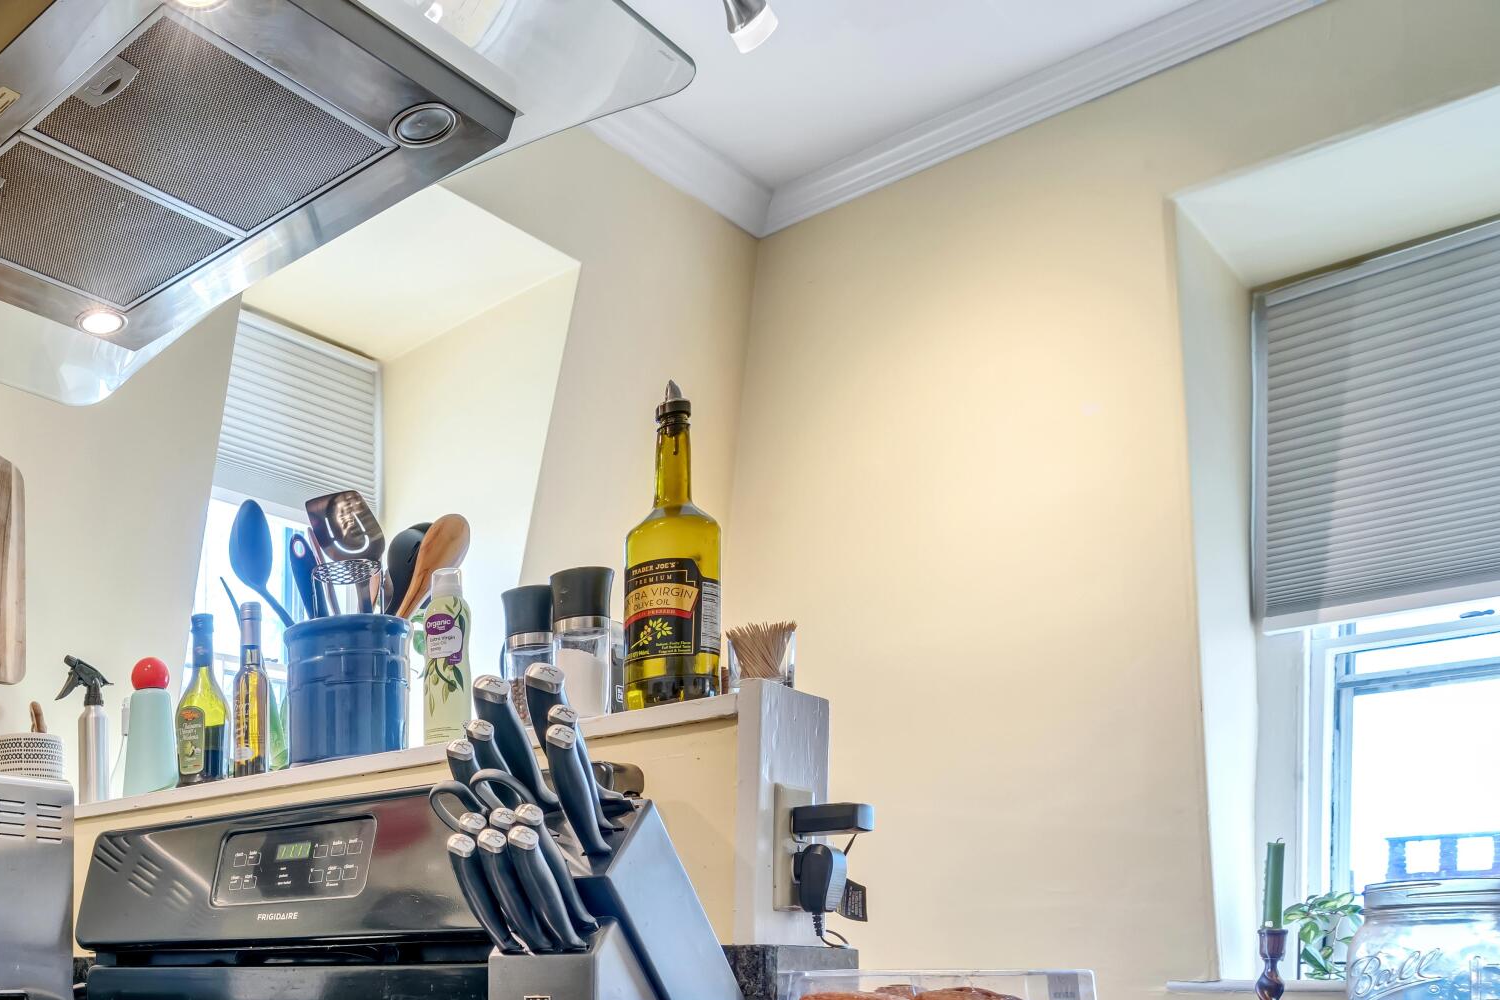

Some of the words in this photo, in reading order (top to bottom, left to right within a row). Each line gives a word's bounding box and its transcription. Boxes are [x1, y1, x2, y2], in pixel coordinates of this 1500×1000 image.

[631, 565, 654, 576] TRADER
[655, 562, 676, 570] JOE'S
[635, 574, 672, 585] PREMIUM
[650, 587, 694, 599] VIRGIN
[427, 620, 451, 628] Organic
[257, 911, 299, 921] FRIGIDAIRE
[1351, 948, 1444, 1000] Ball
